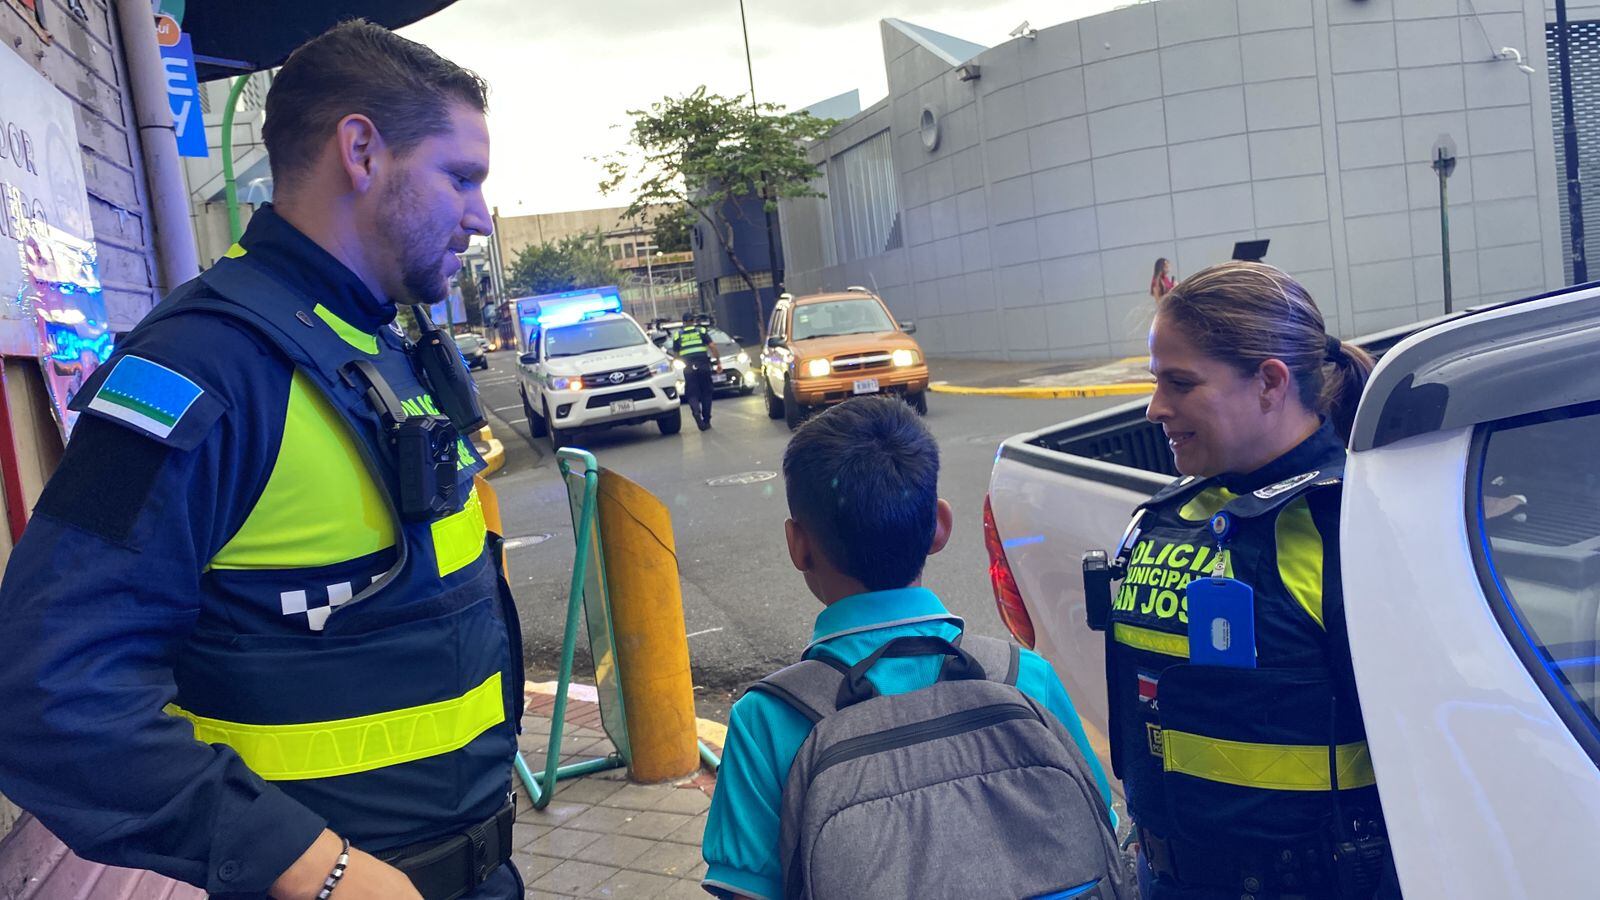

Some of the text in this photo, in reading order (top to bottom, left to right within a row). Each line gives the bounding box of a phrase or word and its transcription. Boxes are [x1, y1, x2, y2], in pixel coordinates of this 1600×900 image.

[1124, 566, 1200, 590] UNICIPA
[1132, 540, 1234, 579] OLICIA
[1113, 585, 1188, 623] AN JOS
